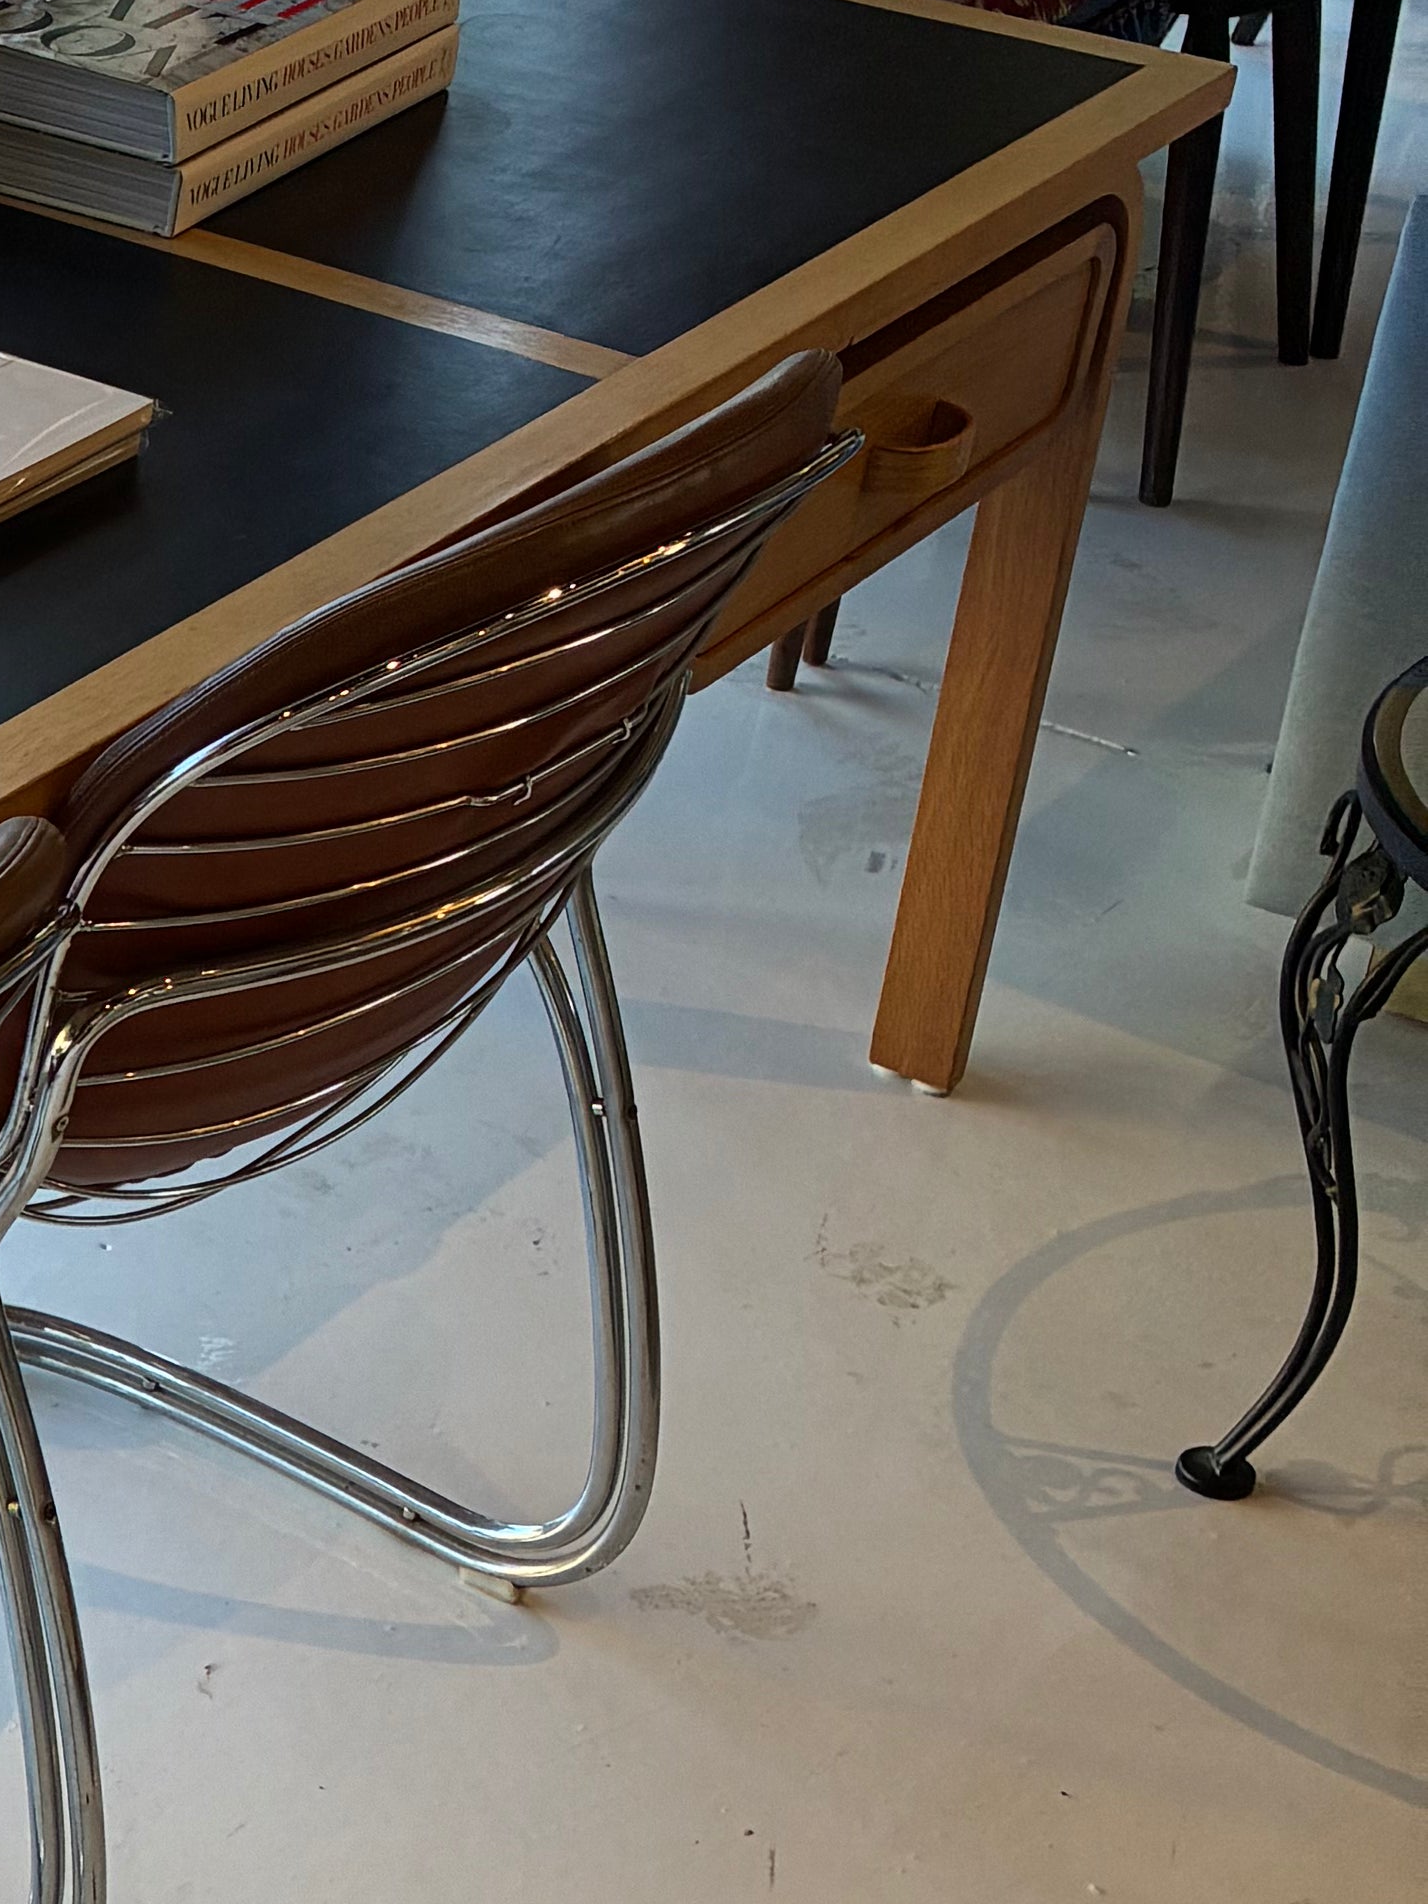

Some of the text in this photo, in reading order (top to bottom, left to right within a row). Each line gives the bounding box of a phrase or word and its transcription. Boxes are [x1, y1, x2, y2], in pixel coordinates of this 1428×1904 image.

[186, 91, 231, 132] VOGUE
[233, 72, 279, 112] LIVING
[190, 171, 231, 207] VOGUE
[233, 146, 280, 185] LIVING
